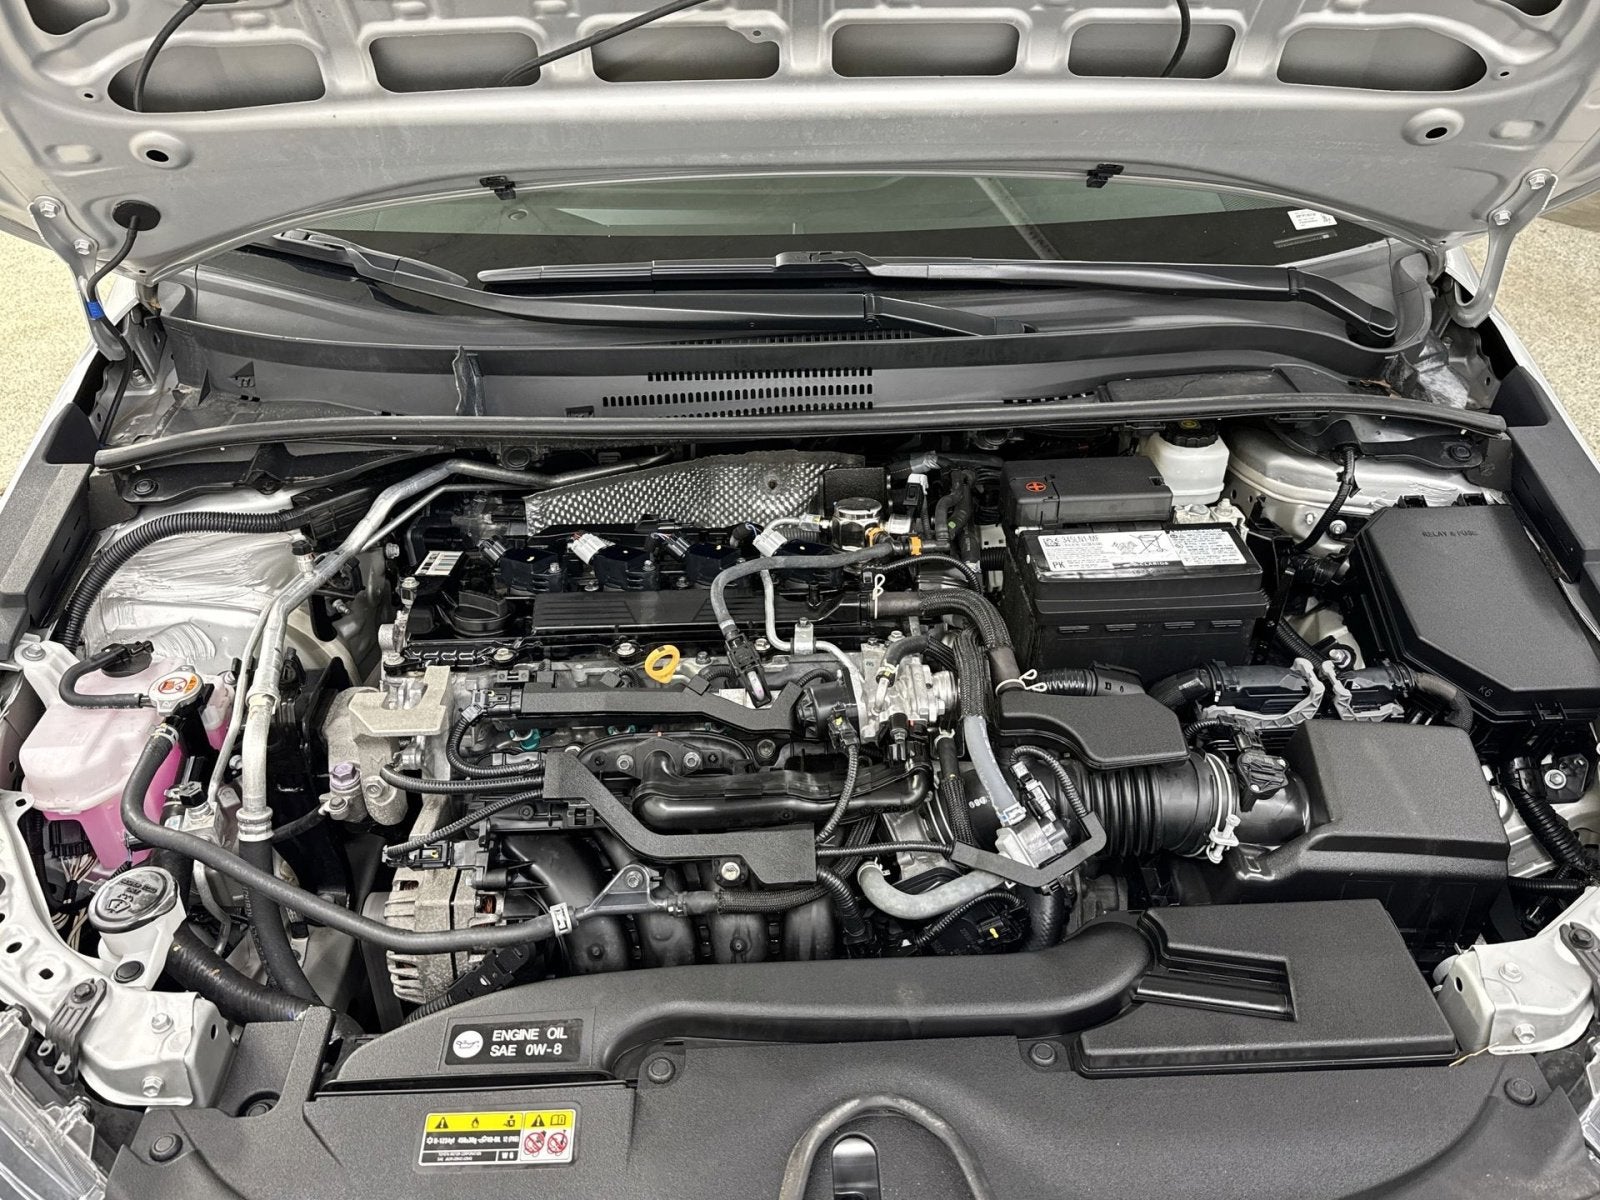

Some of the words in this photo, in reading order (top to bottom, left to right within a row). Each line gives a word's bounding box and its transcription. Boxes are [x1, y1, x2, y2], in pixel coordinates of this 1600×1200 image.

[1052, 561, 1065, 569] PK
[492, 1028, 540, 1042] ENGINE
[546, 1027, 568, 1040] OIL
[489, 1044, 518, 1057] SAE
[525, 1042, 563, 1056] 0W-8
